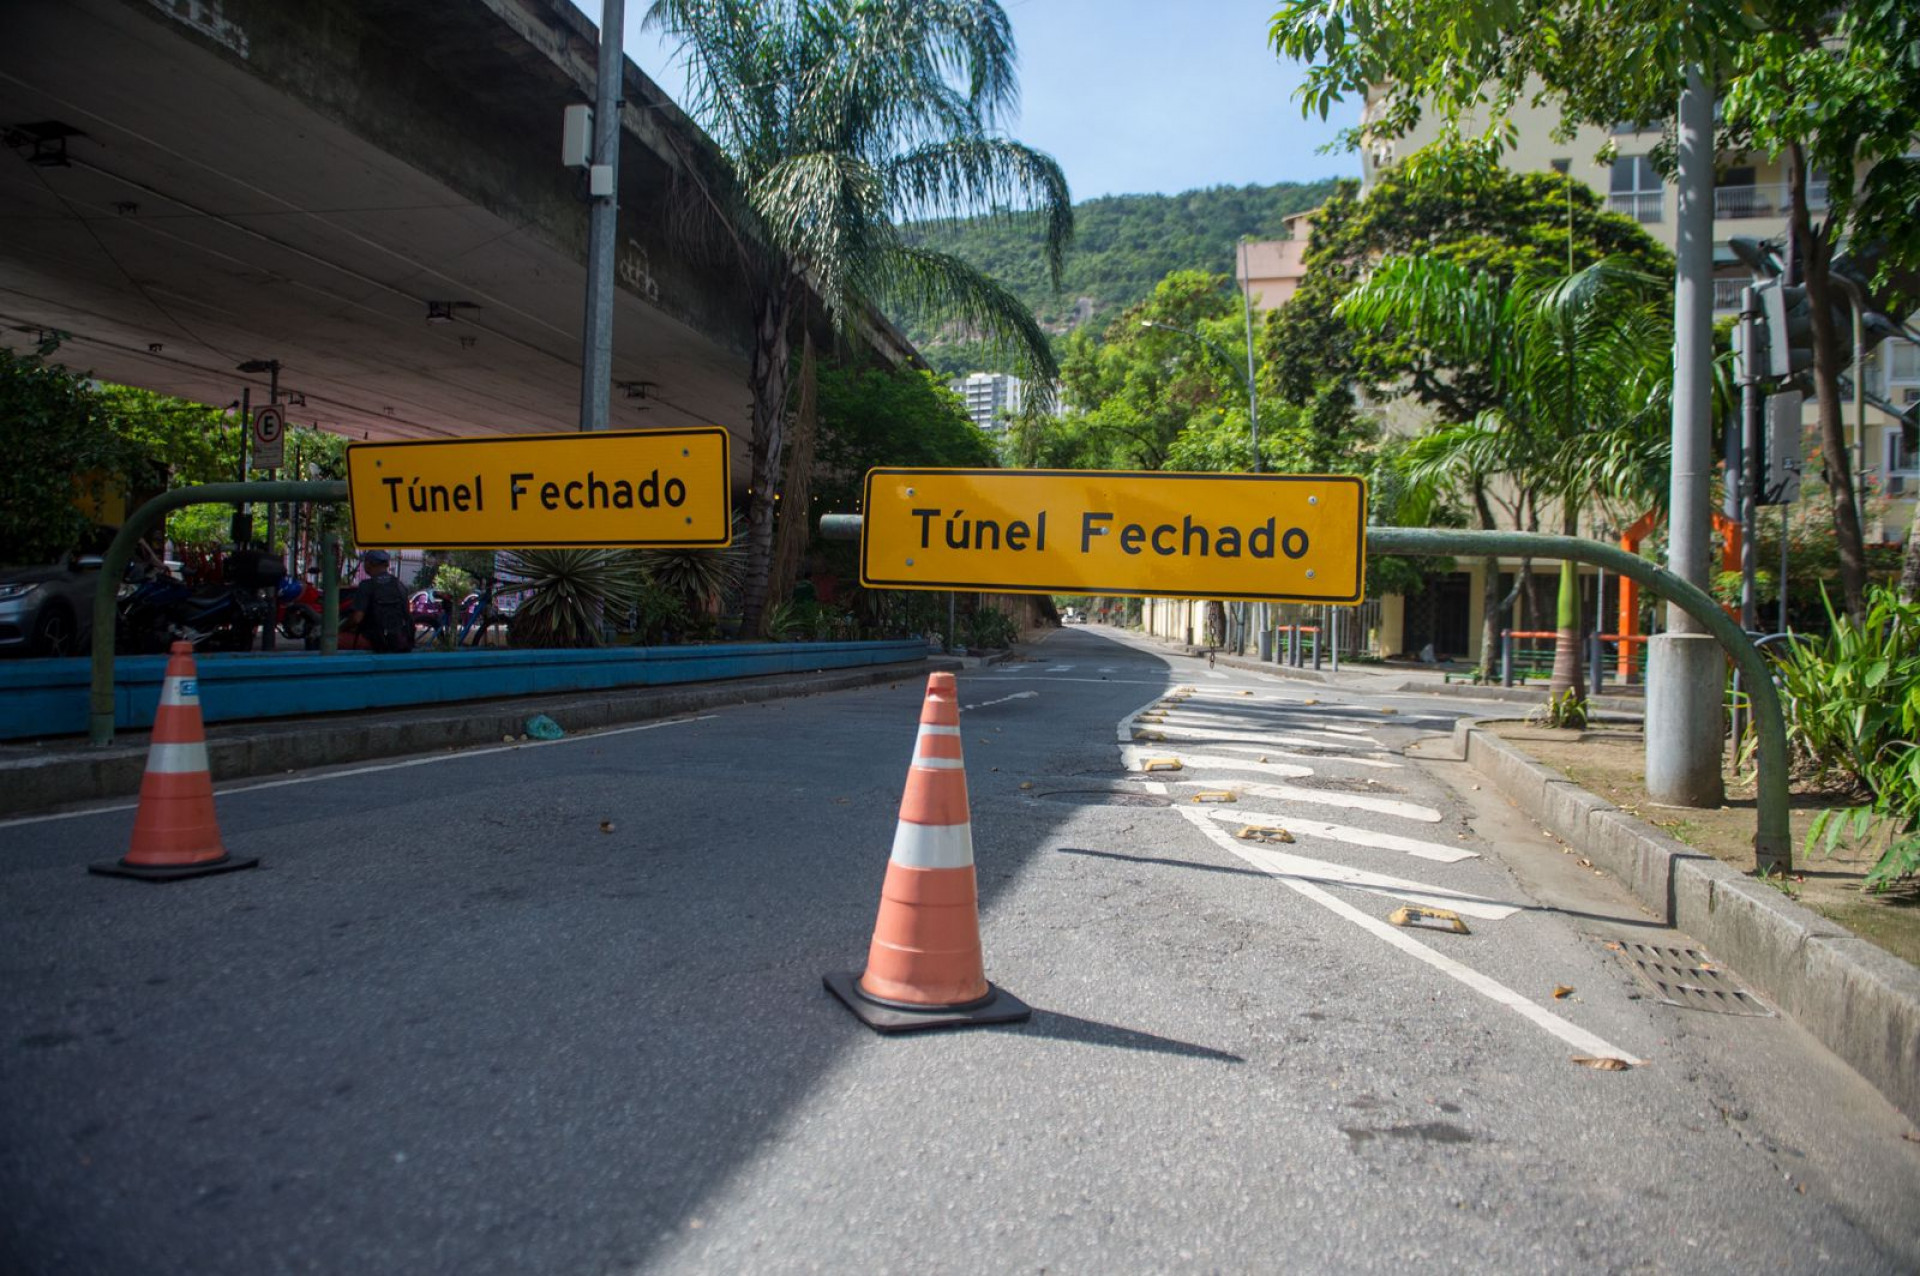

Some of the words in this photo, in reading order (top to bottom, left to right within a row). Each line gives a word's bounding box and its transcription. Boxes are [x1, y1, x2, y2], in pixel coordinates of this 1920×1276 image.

[264, 415, 274, 435] E
[381, 474, 484, 514] Túnel
[510, 469, 687, 512] Fechado
[911, 509, 1046, 552] Túnel
[1081, 513, 1310, 559] Fechado
